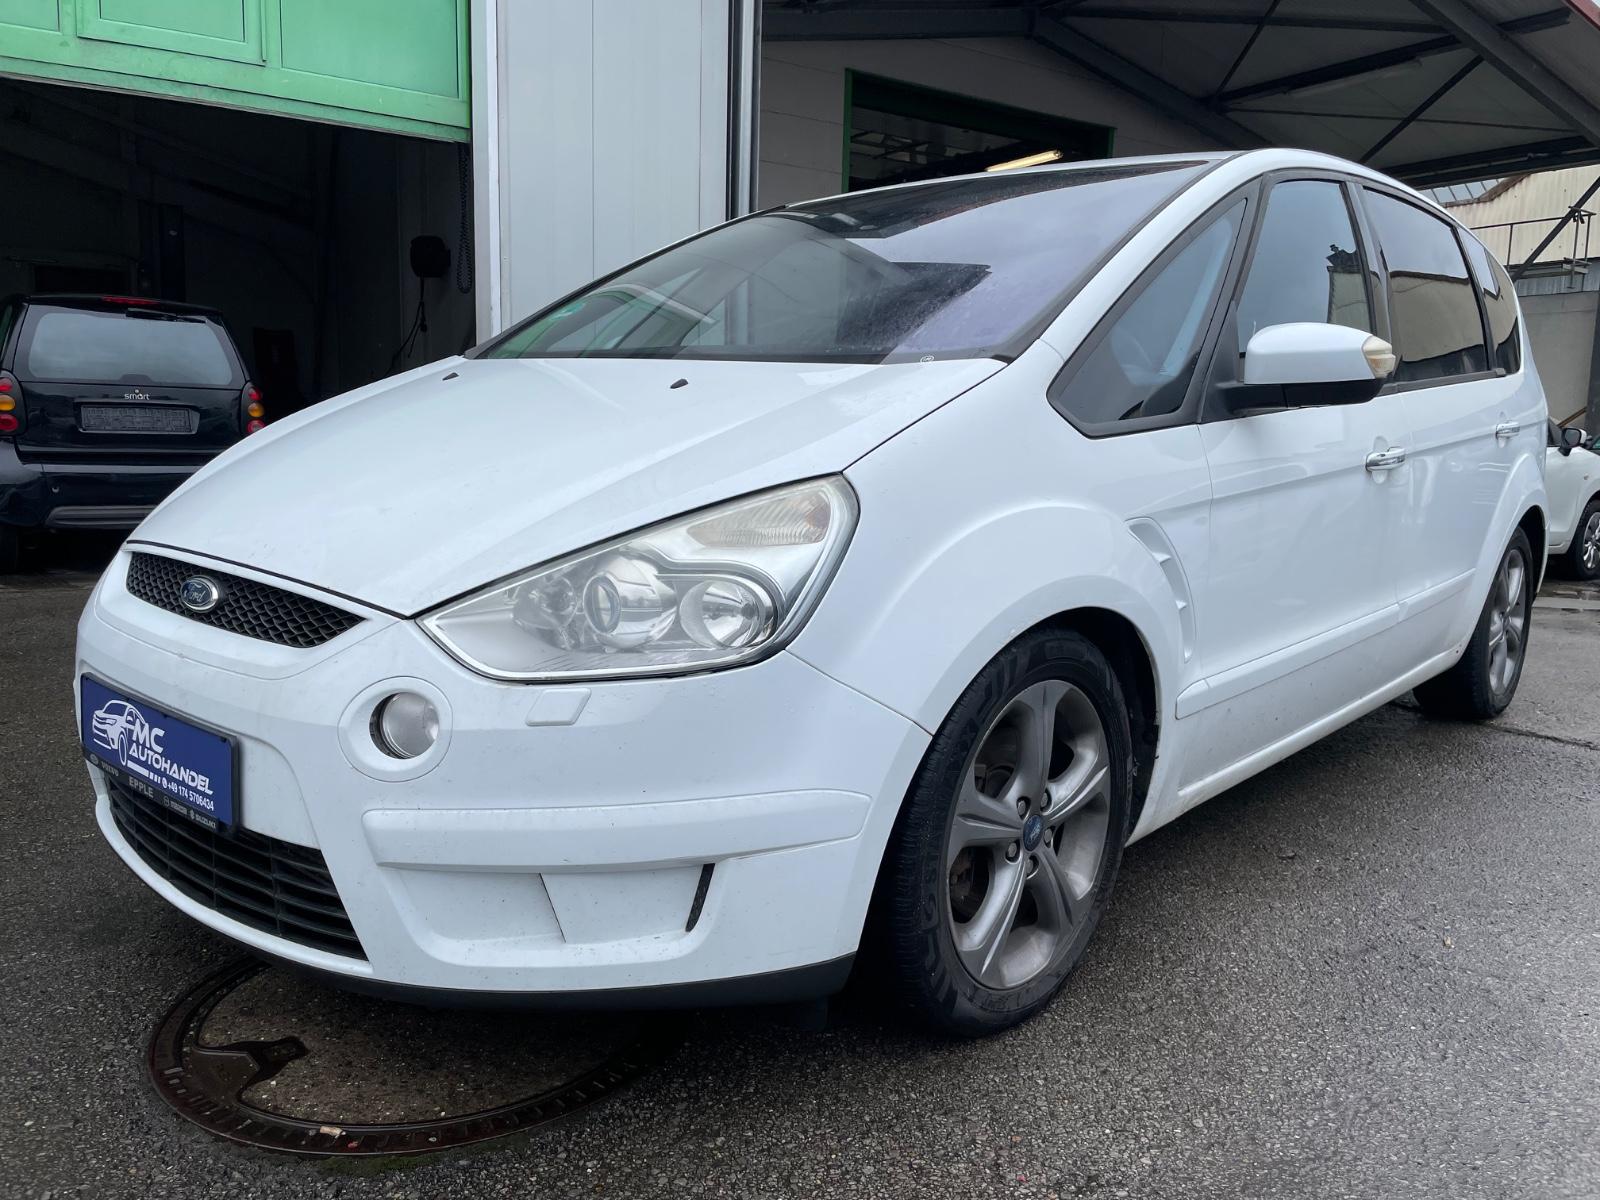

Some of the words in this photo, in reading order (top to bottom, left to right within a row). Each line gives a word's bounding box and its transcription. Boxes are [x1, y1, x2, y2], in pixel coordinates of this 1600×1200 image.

[124, 389, 150, 400] smart
[132, 718, 165, 753] MC
[128, 743, 214, 796] AUTOHANDEL
[129, 776, 154, 798] EPPLE
[179, 785, 189, 798] 174
[189, 791, 214, 811] 5706434
